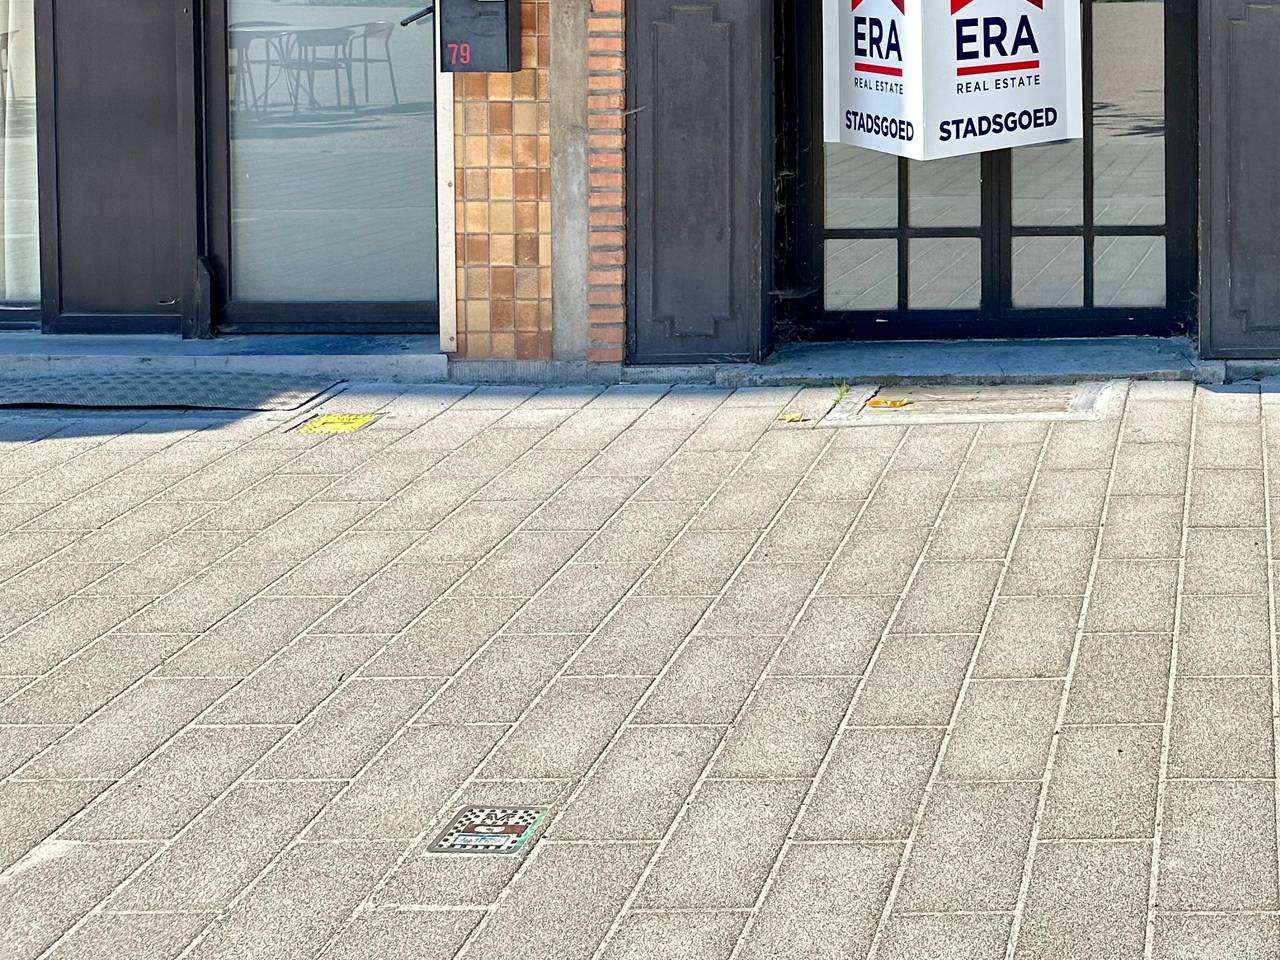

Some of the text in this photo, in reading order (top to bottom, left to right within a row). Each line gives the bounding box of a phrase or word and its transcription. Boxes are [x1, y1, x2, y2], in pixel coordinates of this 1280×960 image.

[447, 43, 471, 65] 79
[854, 16, 903, 61] ERA
[955, 14, 1040, 61] ERA
[854, 77, 904, 95] REAL ESTATE
[956, 74, 1041, 95] REAL ESTATE
[845, 109, 914, 142] STADSGOED
[938, 106, 1058, 142] STADSGOED
